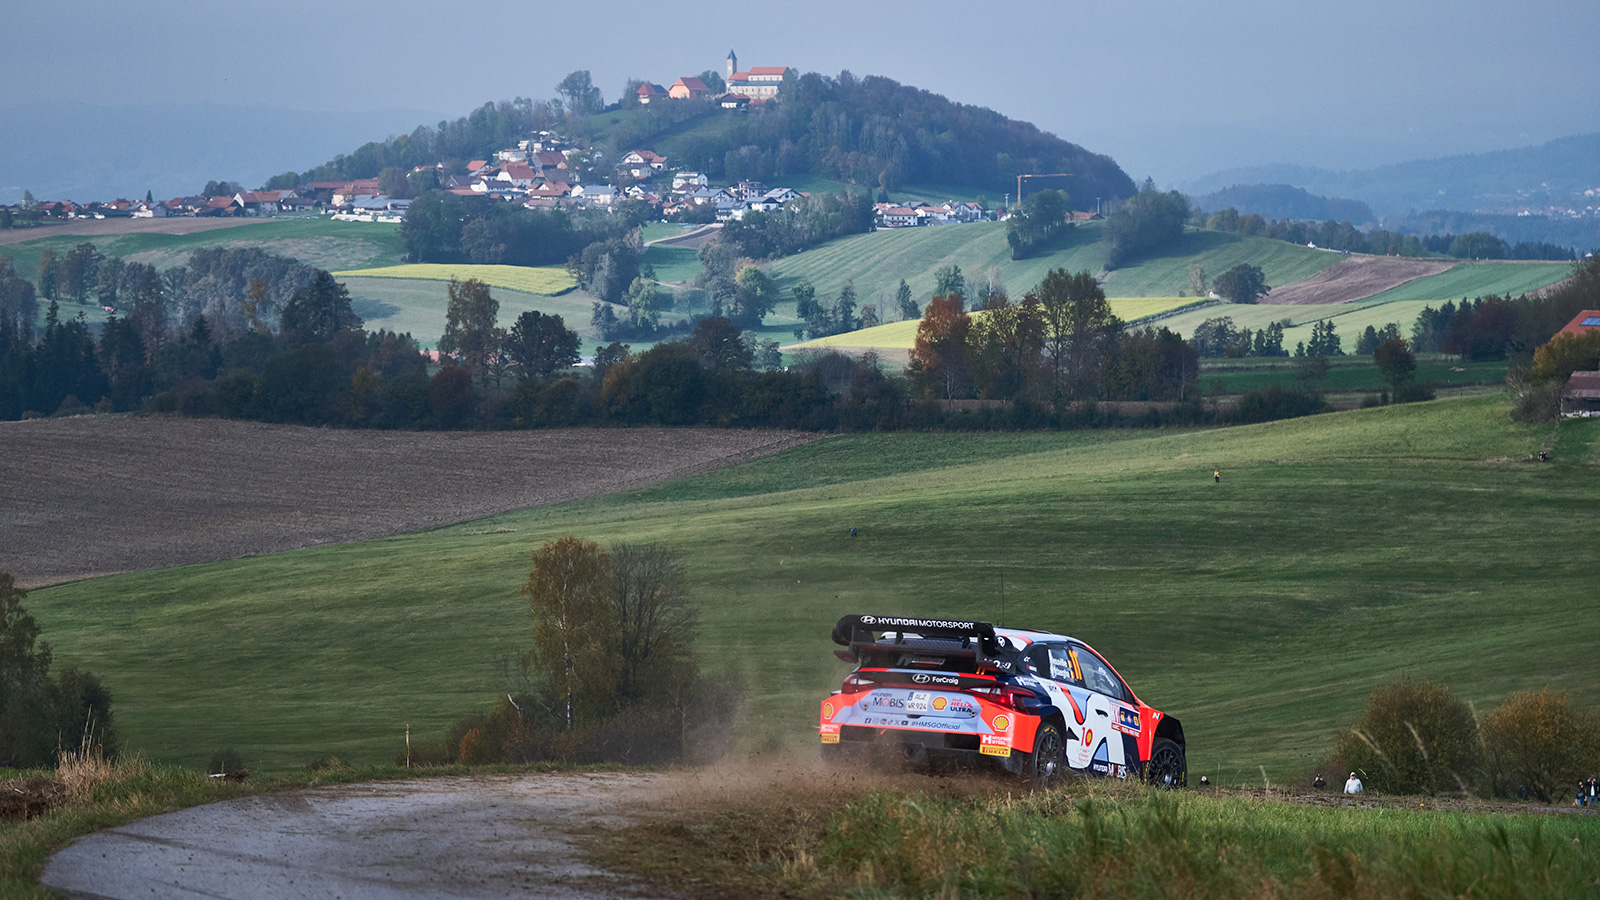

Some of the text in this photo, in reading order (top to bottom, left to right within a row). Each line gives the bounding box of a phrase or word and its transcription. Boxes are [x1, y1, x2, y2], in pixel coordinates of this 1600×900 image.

[878, 617, 975, 630] HYUNDAI MOTORSPORT
[932, 676, 959, 685] ForCraig
[873, 697, 905, 709] MOBIS
[911, 721, 961, 730] #HMSGOfficial
